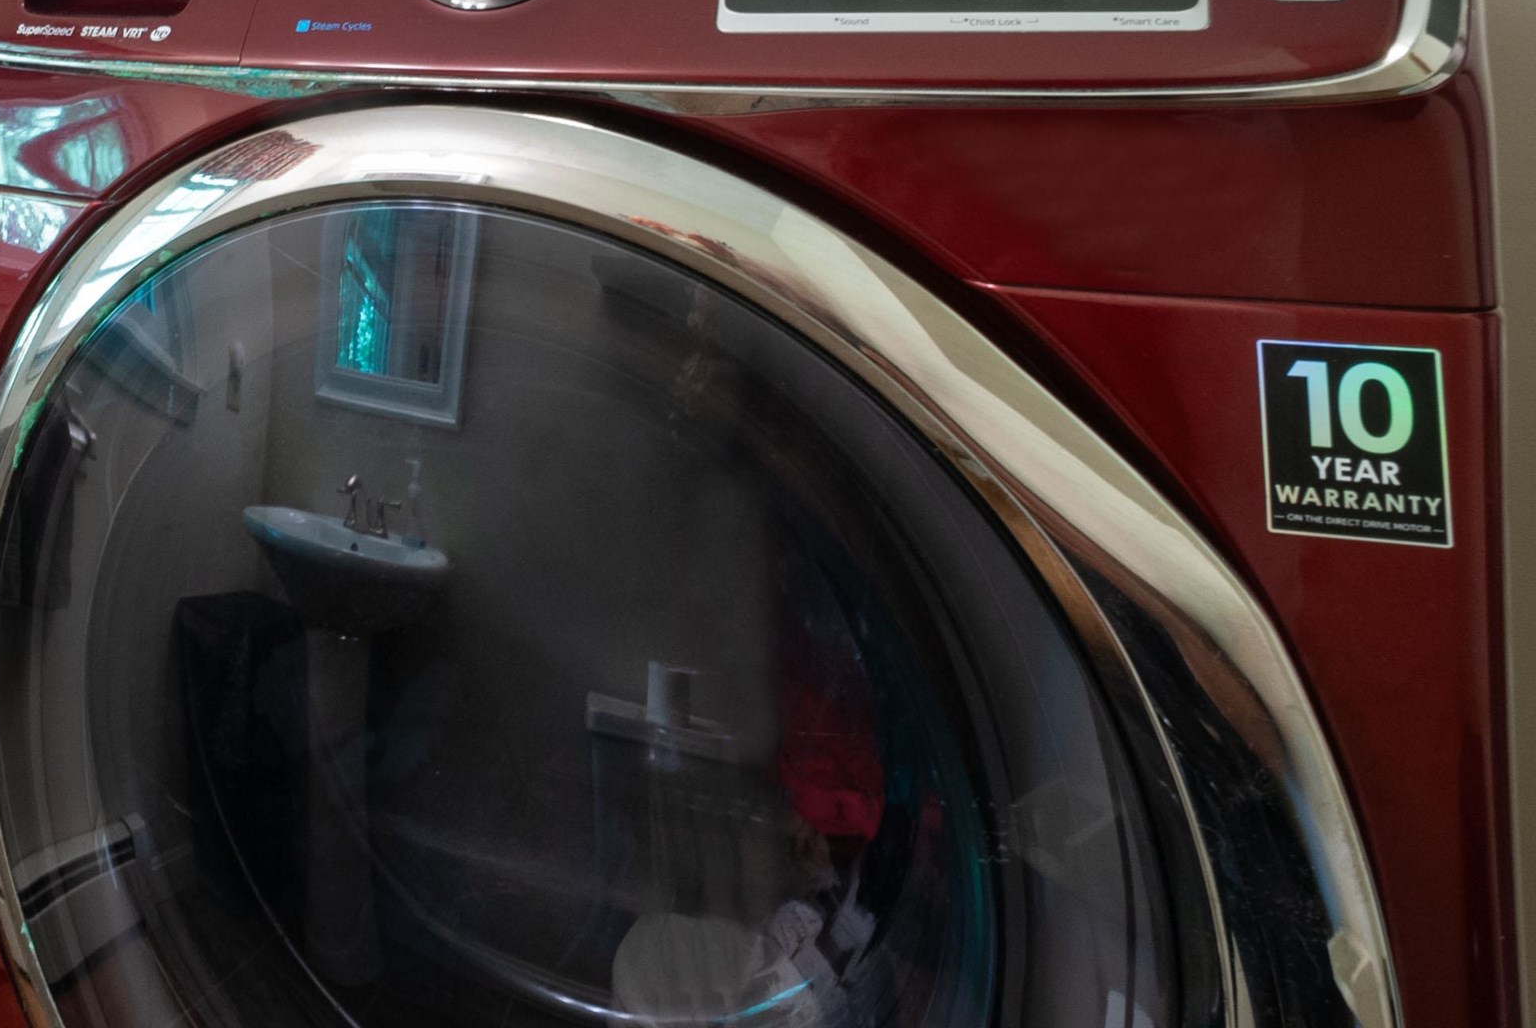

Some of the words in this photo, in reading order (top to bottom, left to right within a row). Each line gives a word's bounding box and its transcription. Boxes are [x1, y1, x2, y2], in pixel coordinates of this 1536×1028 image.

[311, 22, 341, 31] Steam
[341, 21, 372, 32] Cycles
[998, 18, 1022, 26] Lock
[1154, 17, 1181, 26] Care
[16, 24, 75, 37] SuperSpeed
[80, 25, 119, 39] STEAM
[1286, 360, 1414, 455] 10
[1311, 455, 1401, 486] YEAR
[1274, 483, 1442, 517] WARRANTY
[1287, 514, 1303, 522] ON
[1305, 515, 1323, 524] THE
[1326, 516, 1360, 527] DIRECT
[1362, 519, 1390, 530] DRIVE
[1393, 522, 1432, 533] MOTOR
